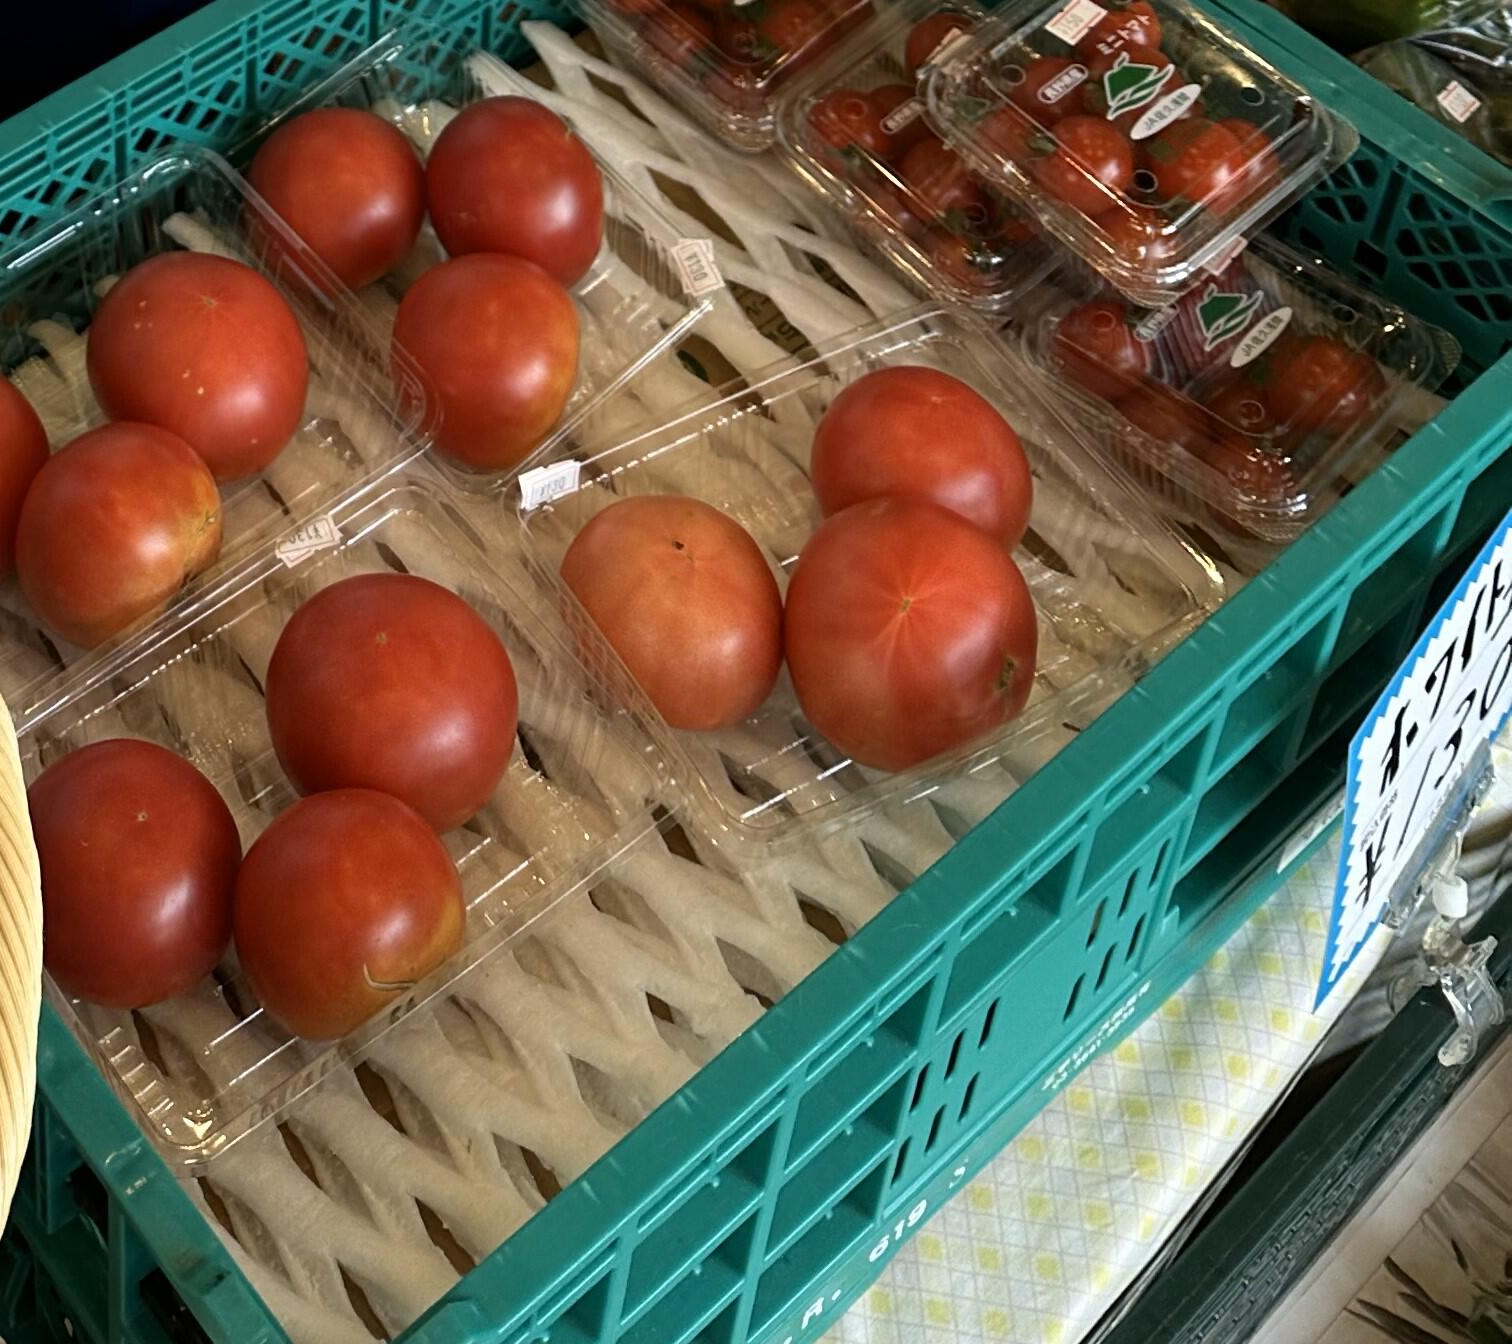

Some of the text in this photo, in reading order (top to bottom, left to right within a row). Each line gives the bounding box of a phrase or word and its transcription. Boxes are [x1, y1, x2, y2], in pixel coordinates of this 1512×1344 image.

[1095, 14, 1151, 56] ミニトマト
